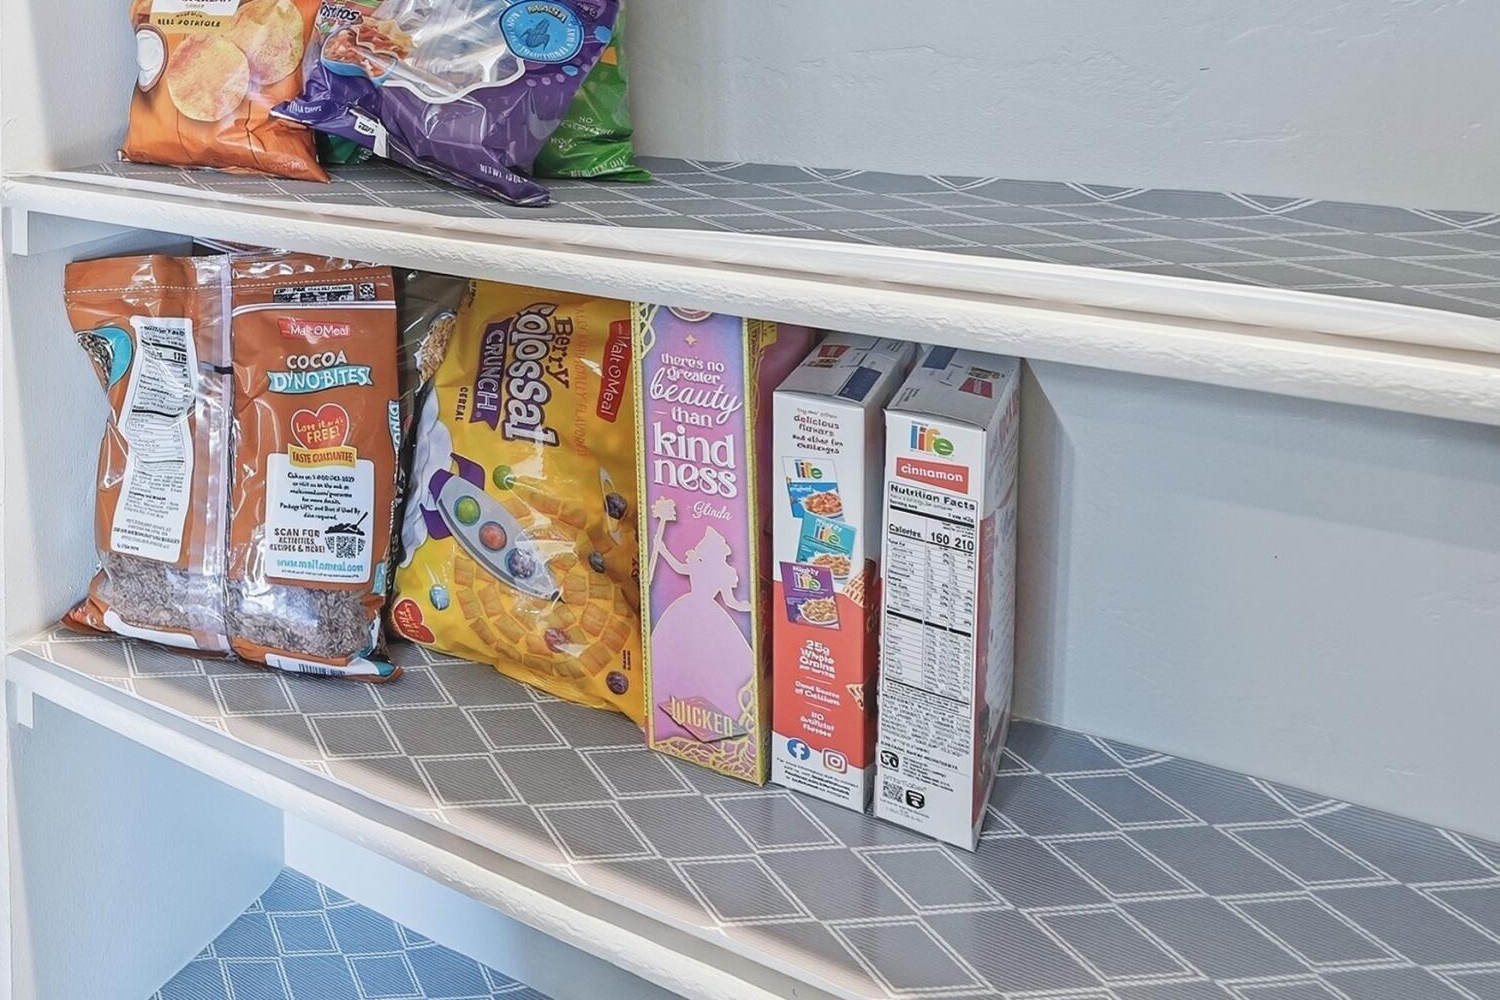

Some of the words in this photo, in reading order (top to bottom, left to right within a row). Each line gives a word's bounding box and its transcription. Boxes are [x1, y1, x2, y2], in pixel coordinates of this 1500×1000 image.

[286, 350, 348, 369] COCOA
[545, 316, 574, 389] Berry
[661, 353, 703, 370] there's
[707, 360, 724, 373] no
[274, 366, 370, 390] DYNO-BITES
[477, 330, 505, 411] CRUNCH
[502, 303, 559, 447] Colossal
[667, 366, 720, 385] greater
[455, 386, 469, 421] CEREAL
[650, 367, 743, 424] beauty
[671, 407, 713, 428] than
[793, 414, 840, 430] delicious
[307, 426, 340, 444] FREE!
[653, 421, 736, 469] kind
[910, 425, 954, 456] life
[292, 451, 312, 464] TASTE
[653, 458, 737, 498] ness
[794, 459, 823, 480] life
[901, 464, 963, 482] cinnamon
[890, 484, 940, 504] Nutrition
[943, 497, 975, 511] Facts
[274, 528, 299, 537] SCAN
[302, 529, 320, 537] FOR
[889, 523, 921, 538] Calories
[931, 532, 950, 545] 160
[954, 538, 974, 551] 210
[799, 656, 836, 673] Grains
[800, 648, 835, 664] Whole
[671, 696, 733, 737] WICKED
